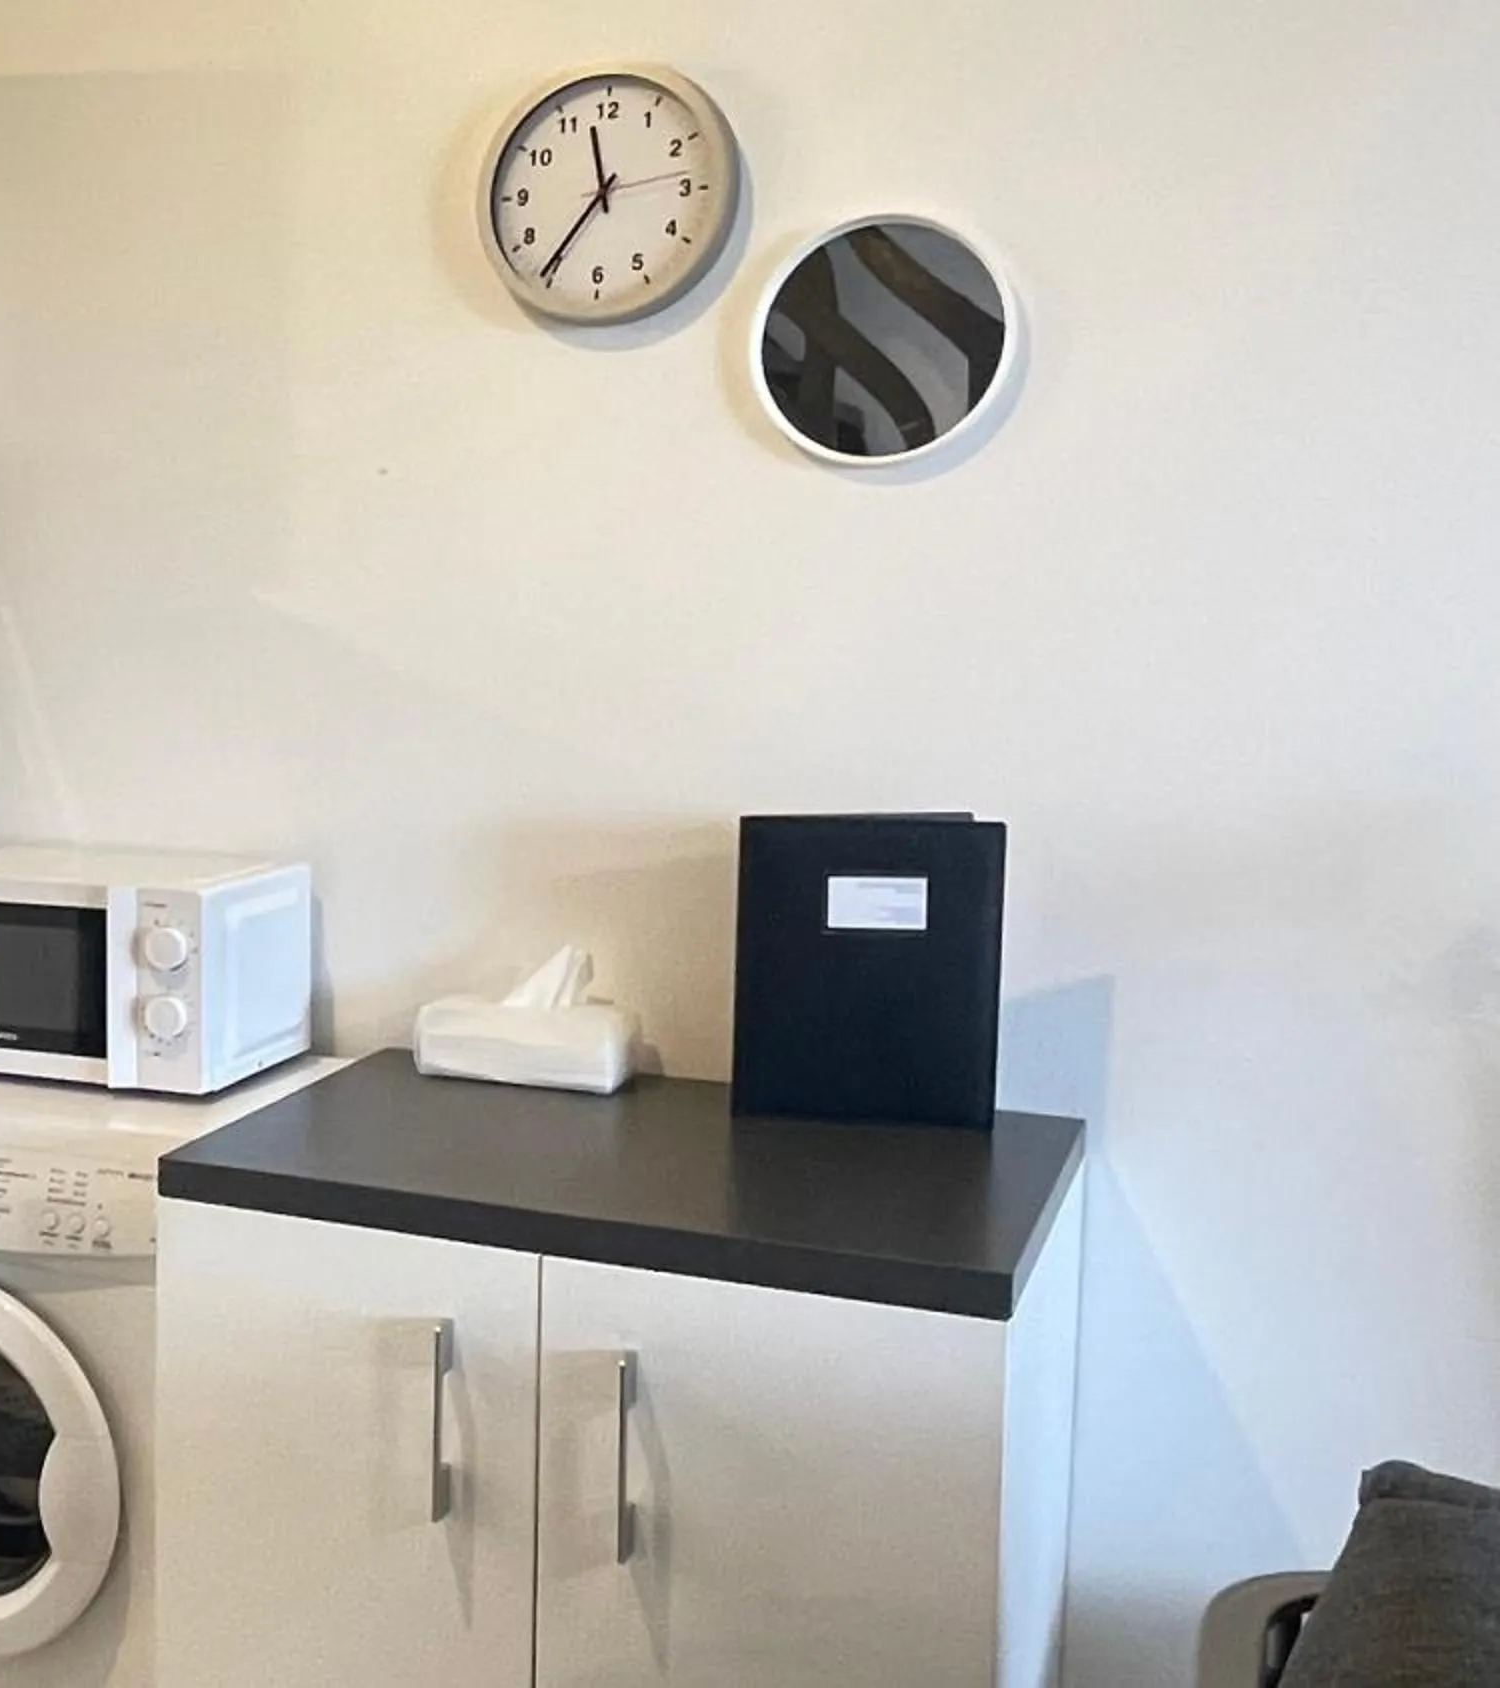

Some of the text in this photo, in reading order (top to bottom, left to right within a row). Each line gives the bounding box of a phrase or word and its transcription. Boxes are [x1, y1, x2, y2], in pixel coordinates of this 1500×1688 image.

[595, 101, 620, 120] 12
[643, 110, 652, 129] 1
[558, 115, 578, 135] 11
[529, 147, 553, 167] 10
[668, 138, 683, 158] 2
[516, 187, 530, 207] 9
[678, 178, 692, 198] 3
[523, 226, 536, 246] 8
[664, 218, 678, 237] 4
[631, 252, 645, 272] 5
[591, 265, 605, 285] 6
